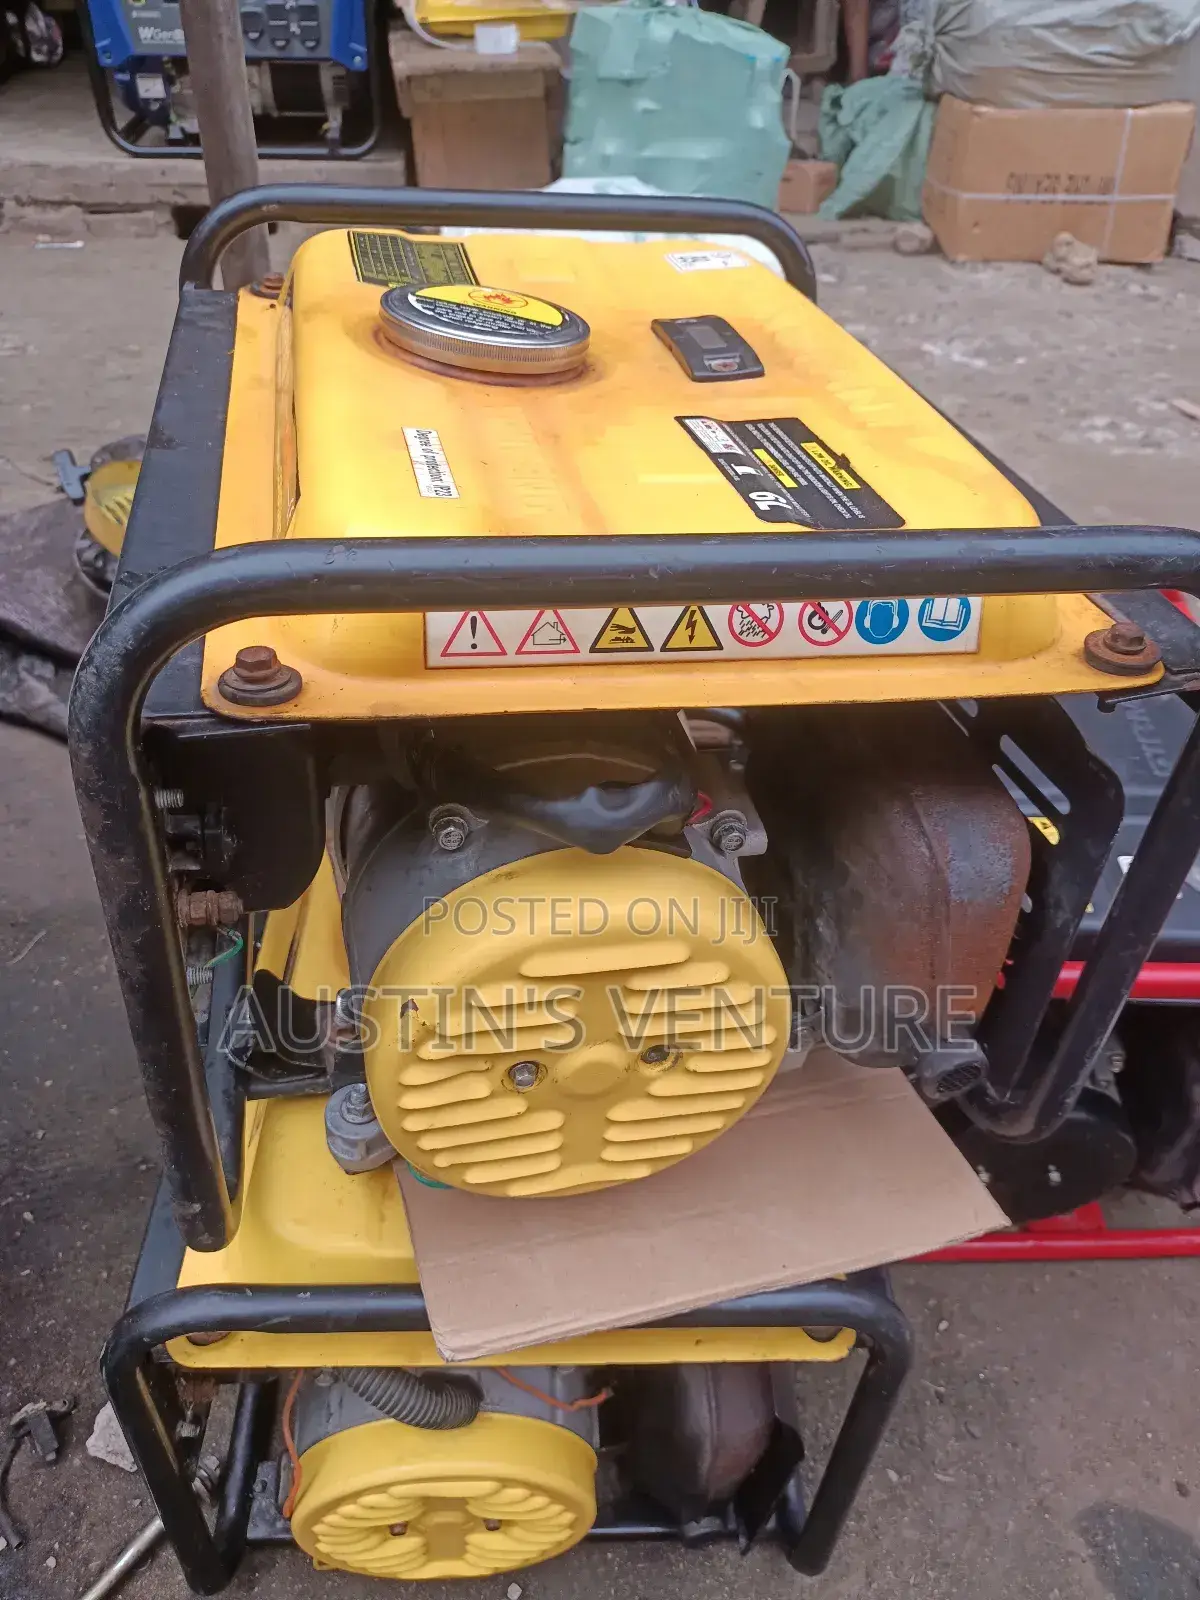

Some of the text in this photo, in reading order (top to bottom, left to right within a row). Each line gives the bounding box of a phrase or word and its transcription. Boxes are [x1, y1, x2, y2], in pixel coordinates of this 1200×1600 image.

[414, 430, 432, 446] Degree
[433, 485, 452, 496] IP23
[749, 491, 792, 510] 6L
